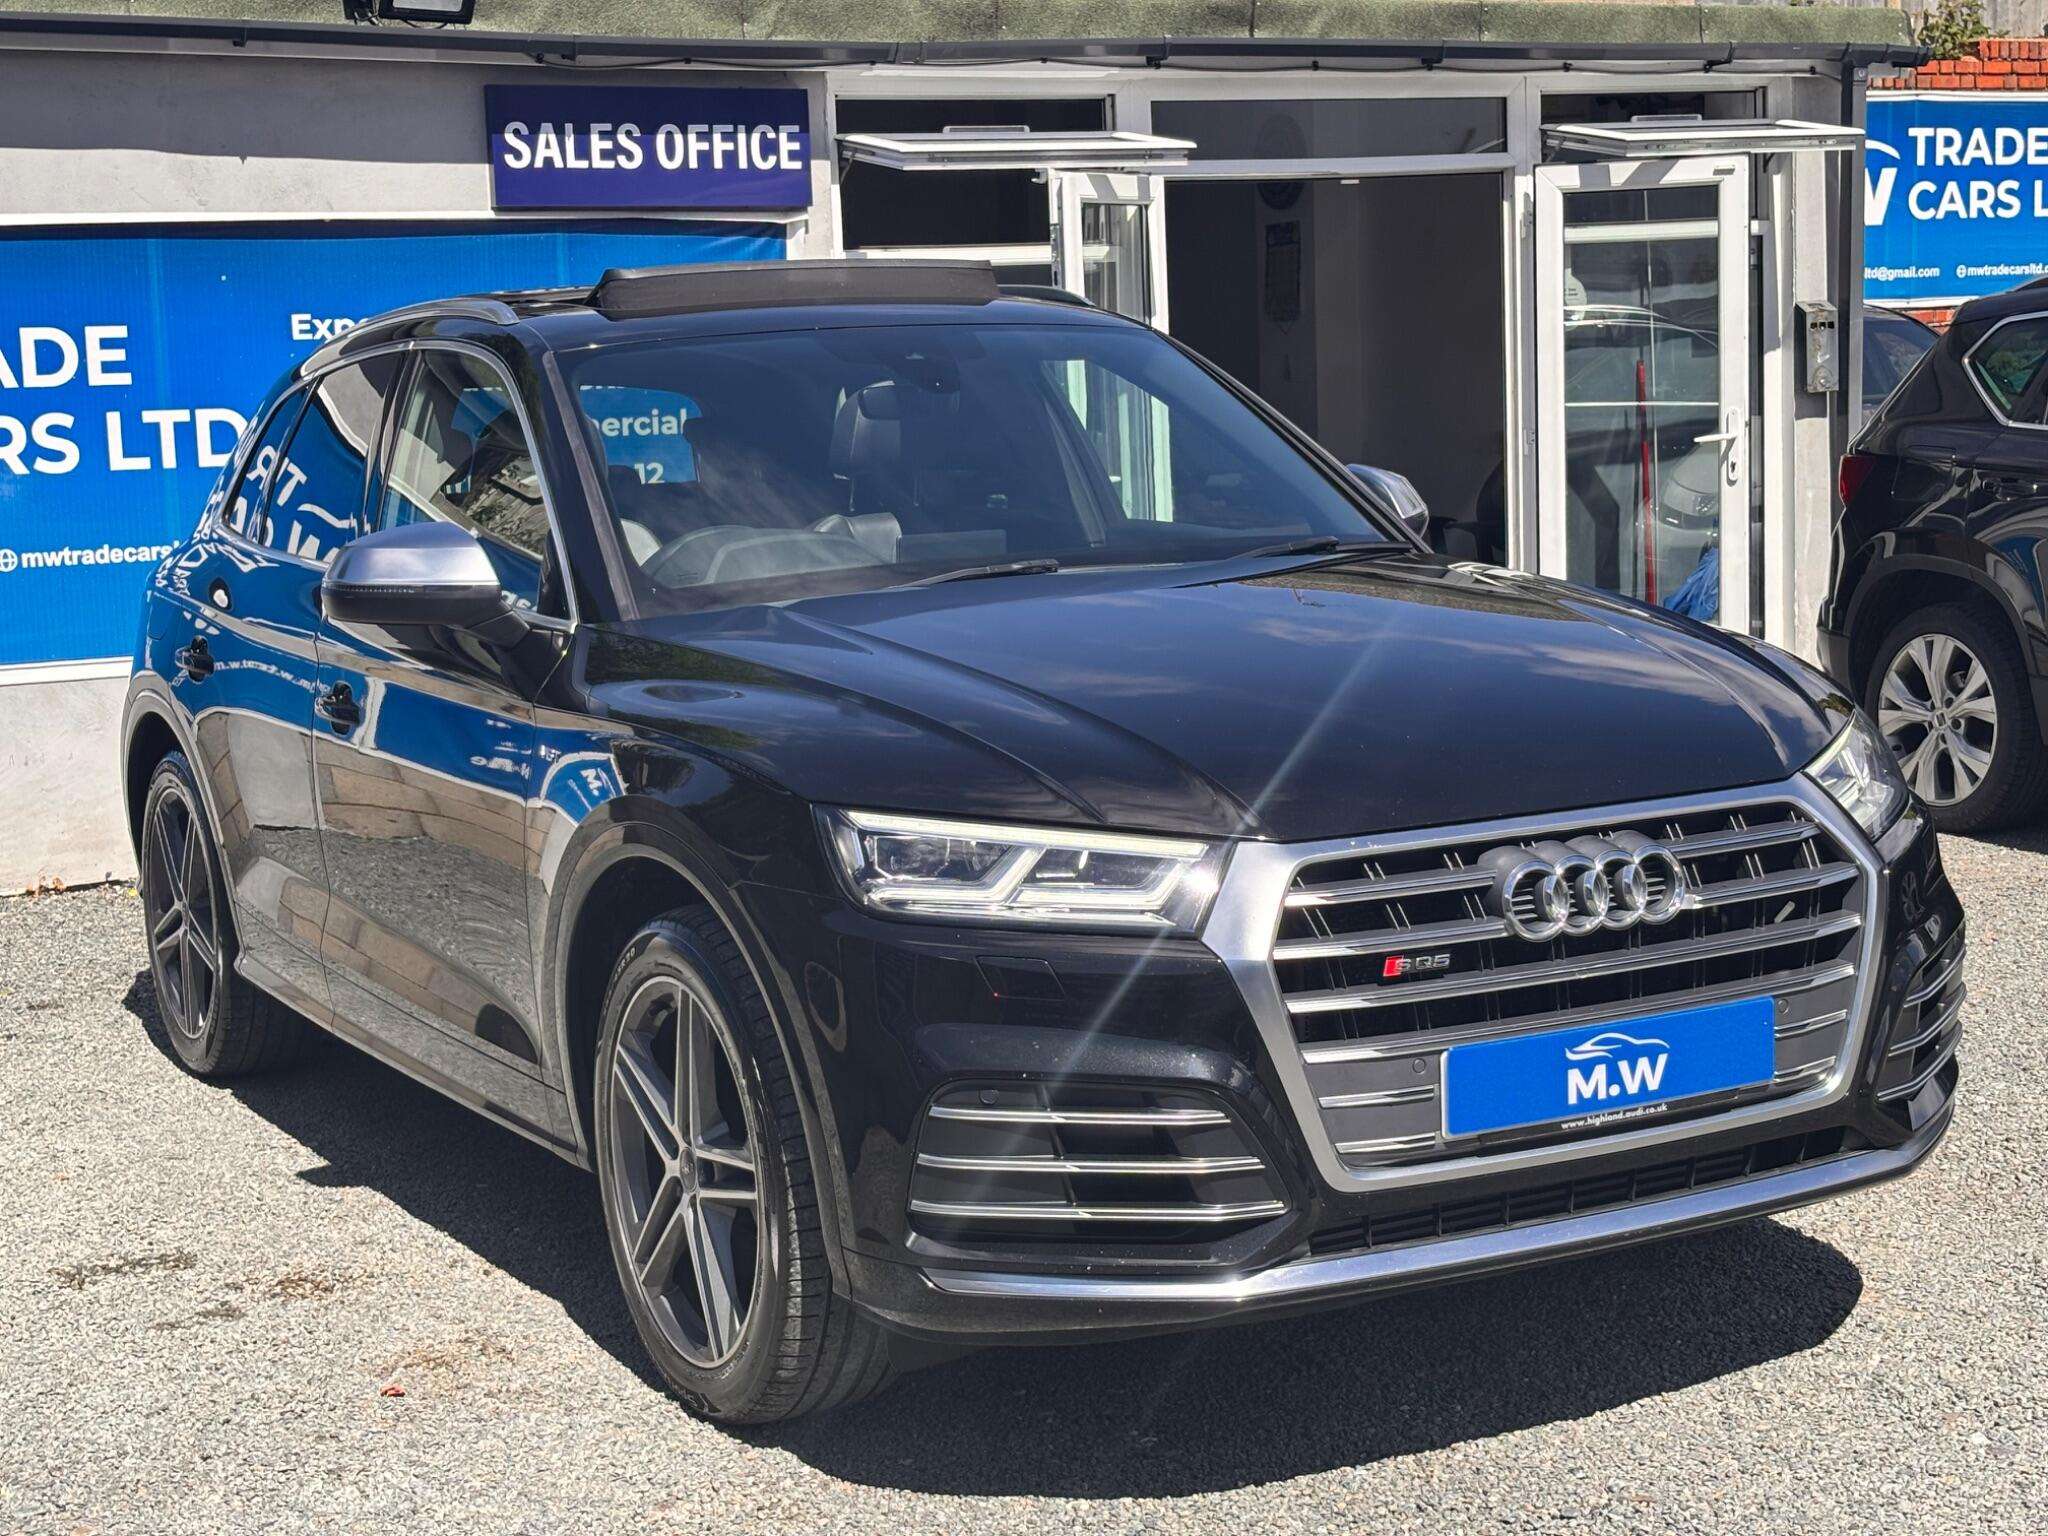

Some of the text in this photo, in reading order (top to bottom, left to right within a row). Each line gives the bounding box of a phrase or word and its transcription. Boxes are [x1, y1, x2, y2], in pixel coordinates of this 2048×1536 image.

[504, 121, 802, 170] SALES OFFICE
[1908, 127, 2048, 166] TRADE
[1908, 180, 2021, 220] CARS
[106, 408, 249, 471] LTD
[1567, 1053, 1669, 1105] M.W
